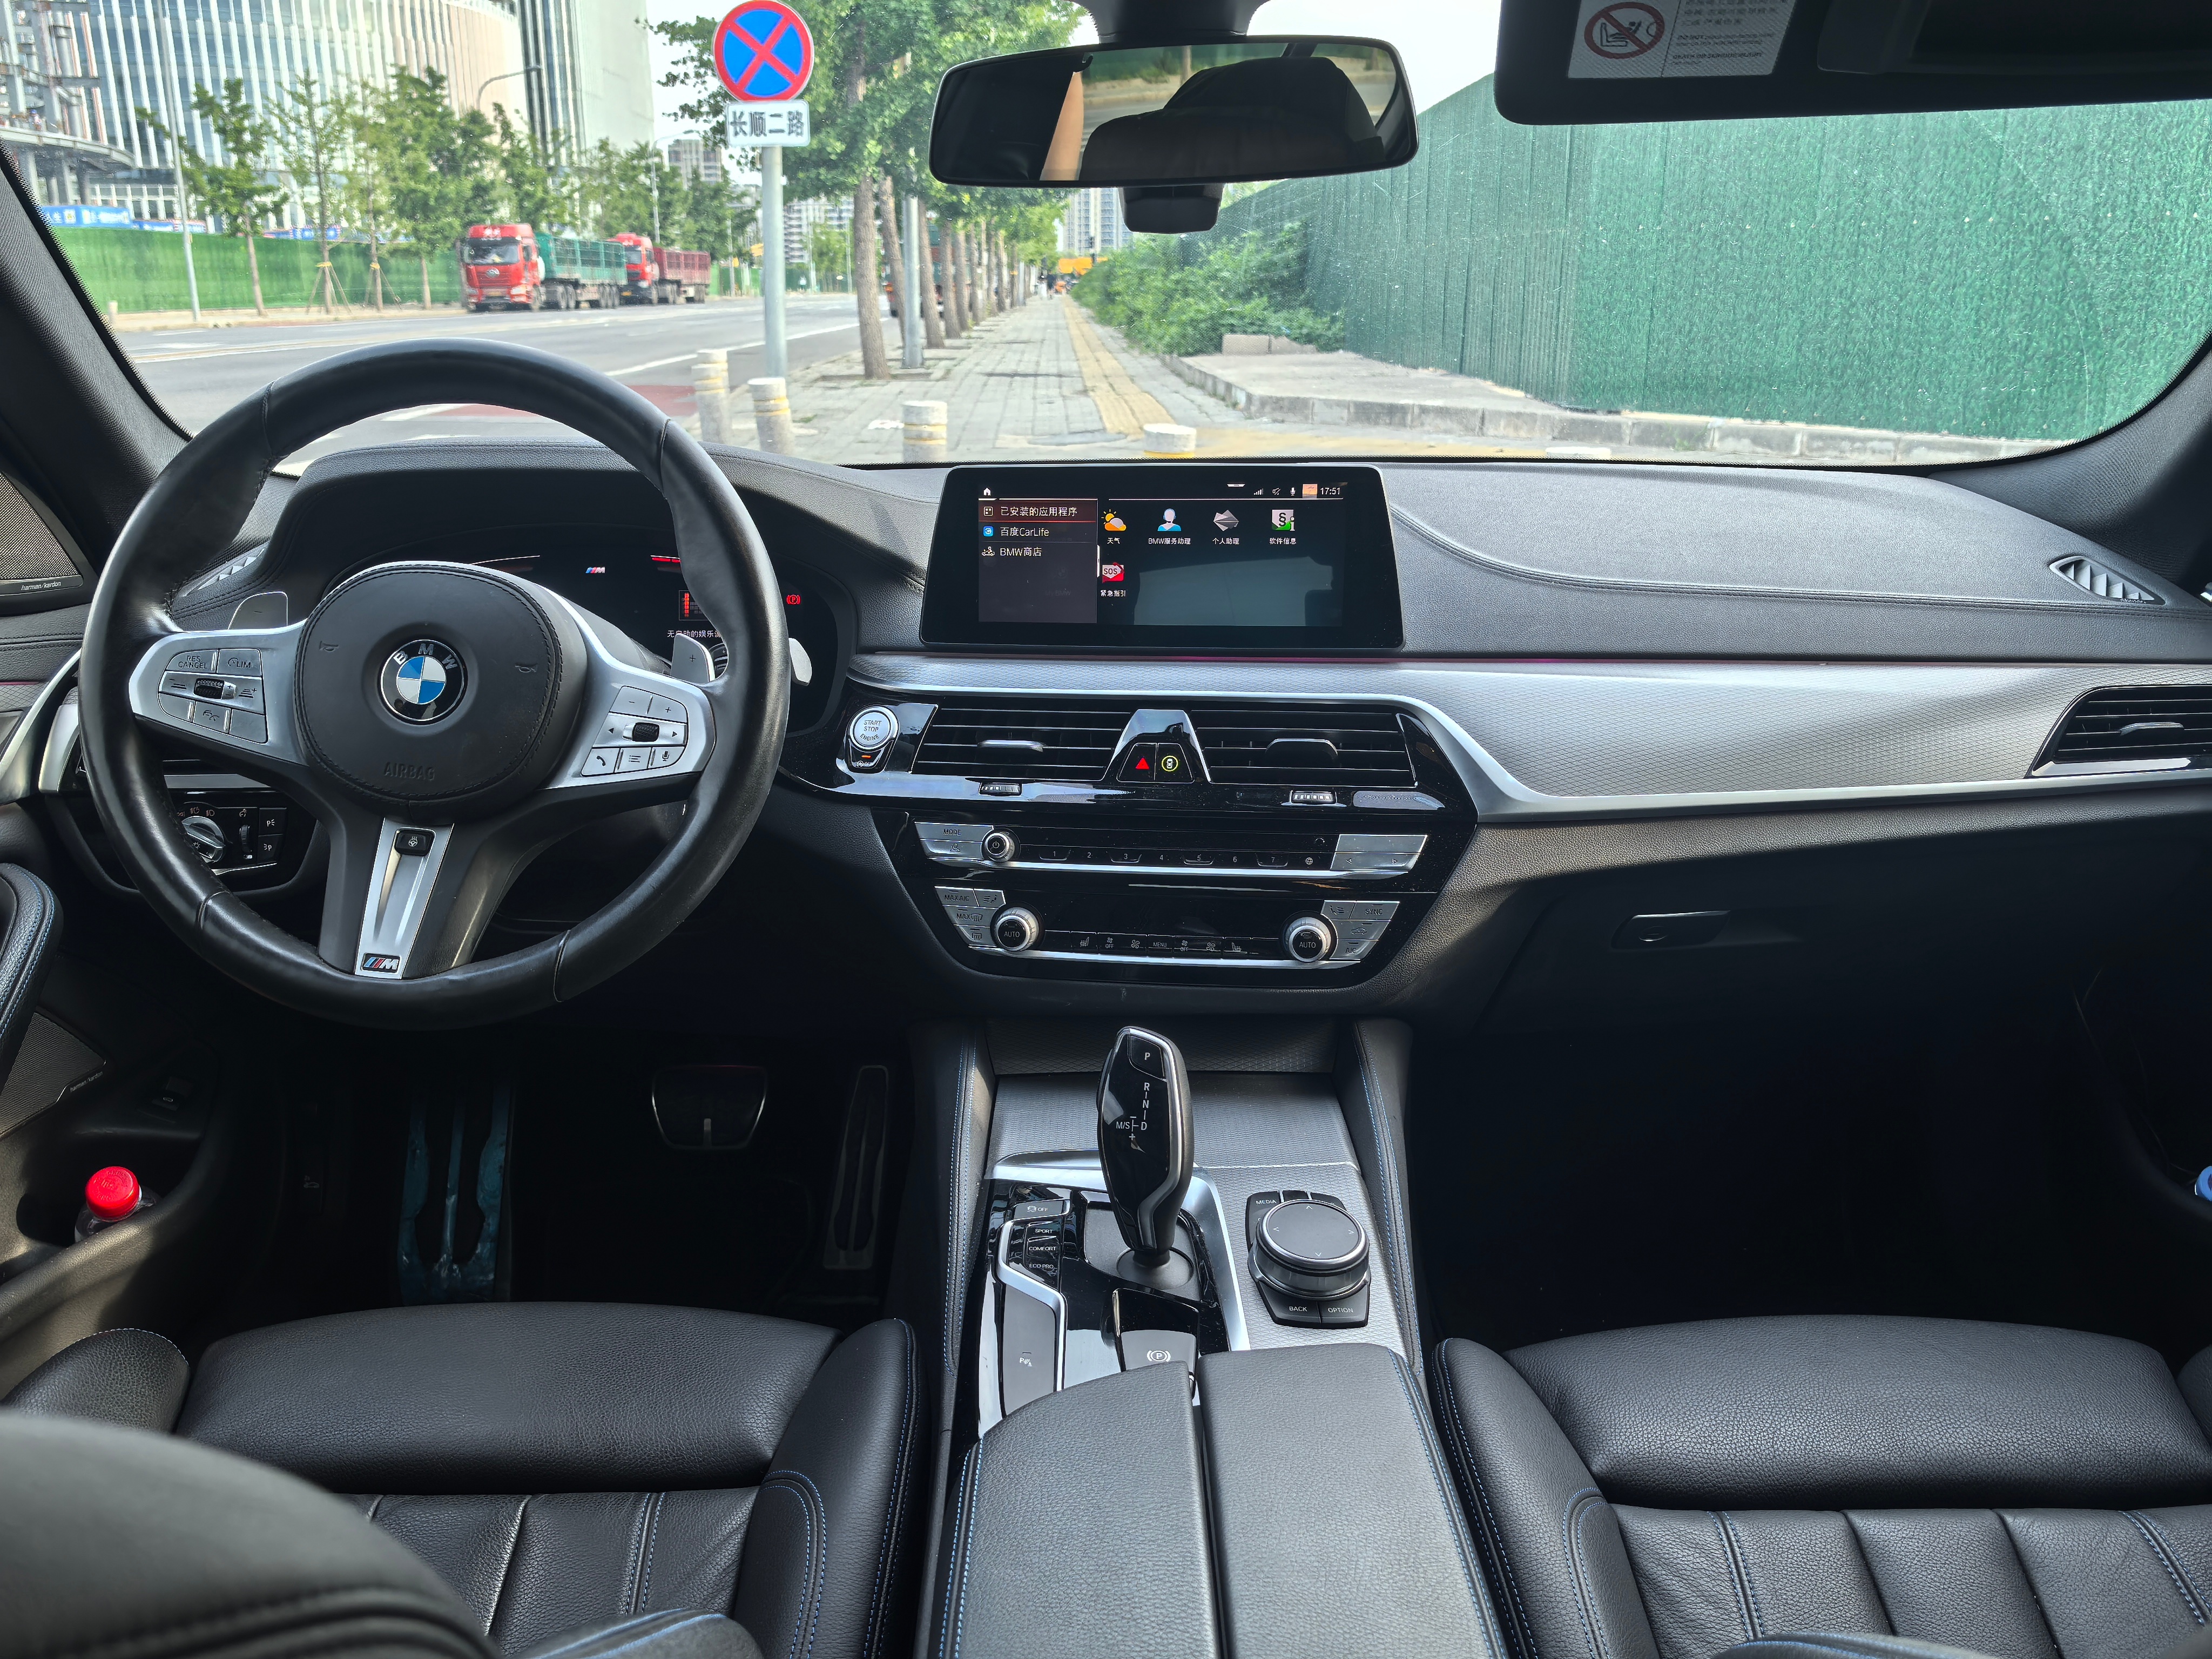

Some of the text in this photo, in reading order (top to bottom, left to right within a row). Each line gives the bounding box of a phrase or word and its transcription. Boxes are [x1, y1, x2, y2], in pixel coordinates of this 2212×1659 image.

[730, 110, 804, 137] 长顺二路
[1320, 487, 1340, 495] 17:51
[1000, 506, 1077, 517] 已安装的应用程序
[1000, 527, 1050, 536] 百度CarLife
[1000, 547, 1042, 557] BMW商店
[21, 581, 61, 591] harman/kardon
[393, 643, 458, 670] BMW
[178, 661, 207, 669] CANCEL
[236, 660, 251, 669] LIM
[383, 762, 435, 781] AIRBAG
[1144, 1052, 1150, 1060] P
[1144, 1082, 1150, 1091] R
[1142, 1100, 1149, 1108] N
[1141, 1122, 1147, 1130] D
